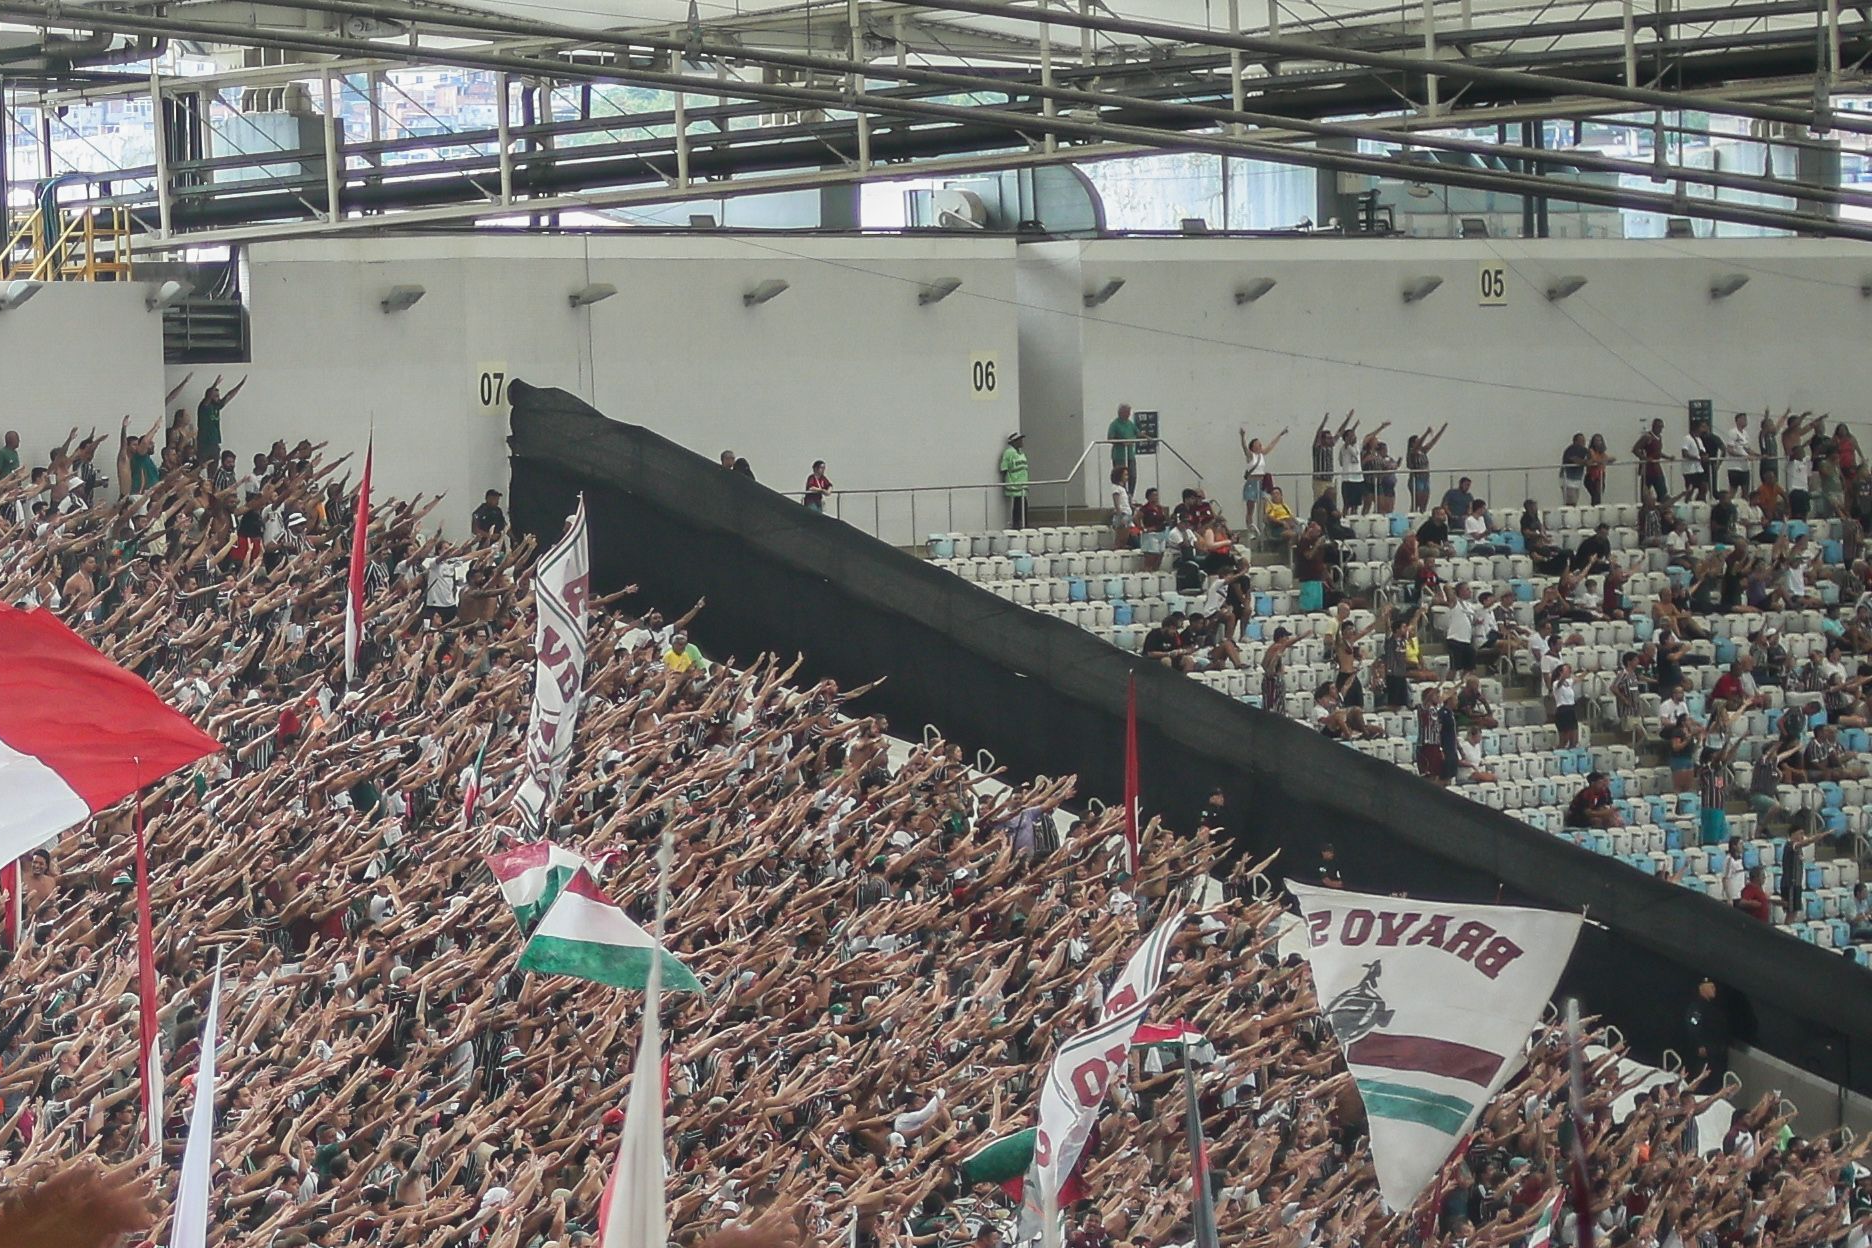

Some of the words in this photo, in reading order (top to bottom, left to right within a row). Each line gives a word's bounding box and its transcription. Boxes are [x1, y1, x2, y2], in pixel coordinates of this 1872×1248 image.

[1481, 269, 1504, 298] 05
[480, 372, 504, 405] 07
[973, 360, 996, 391] 06
